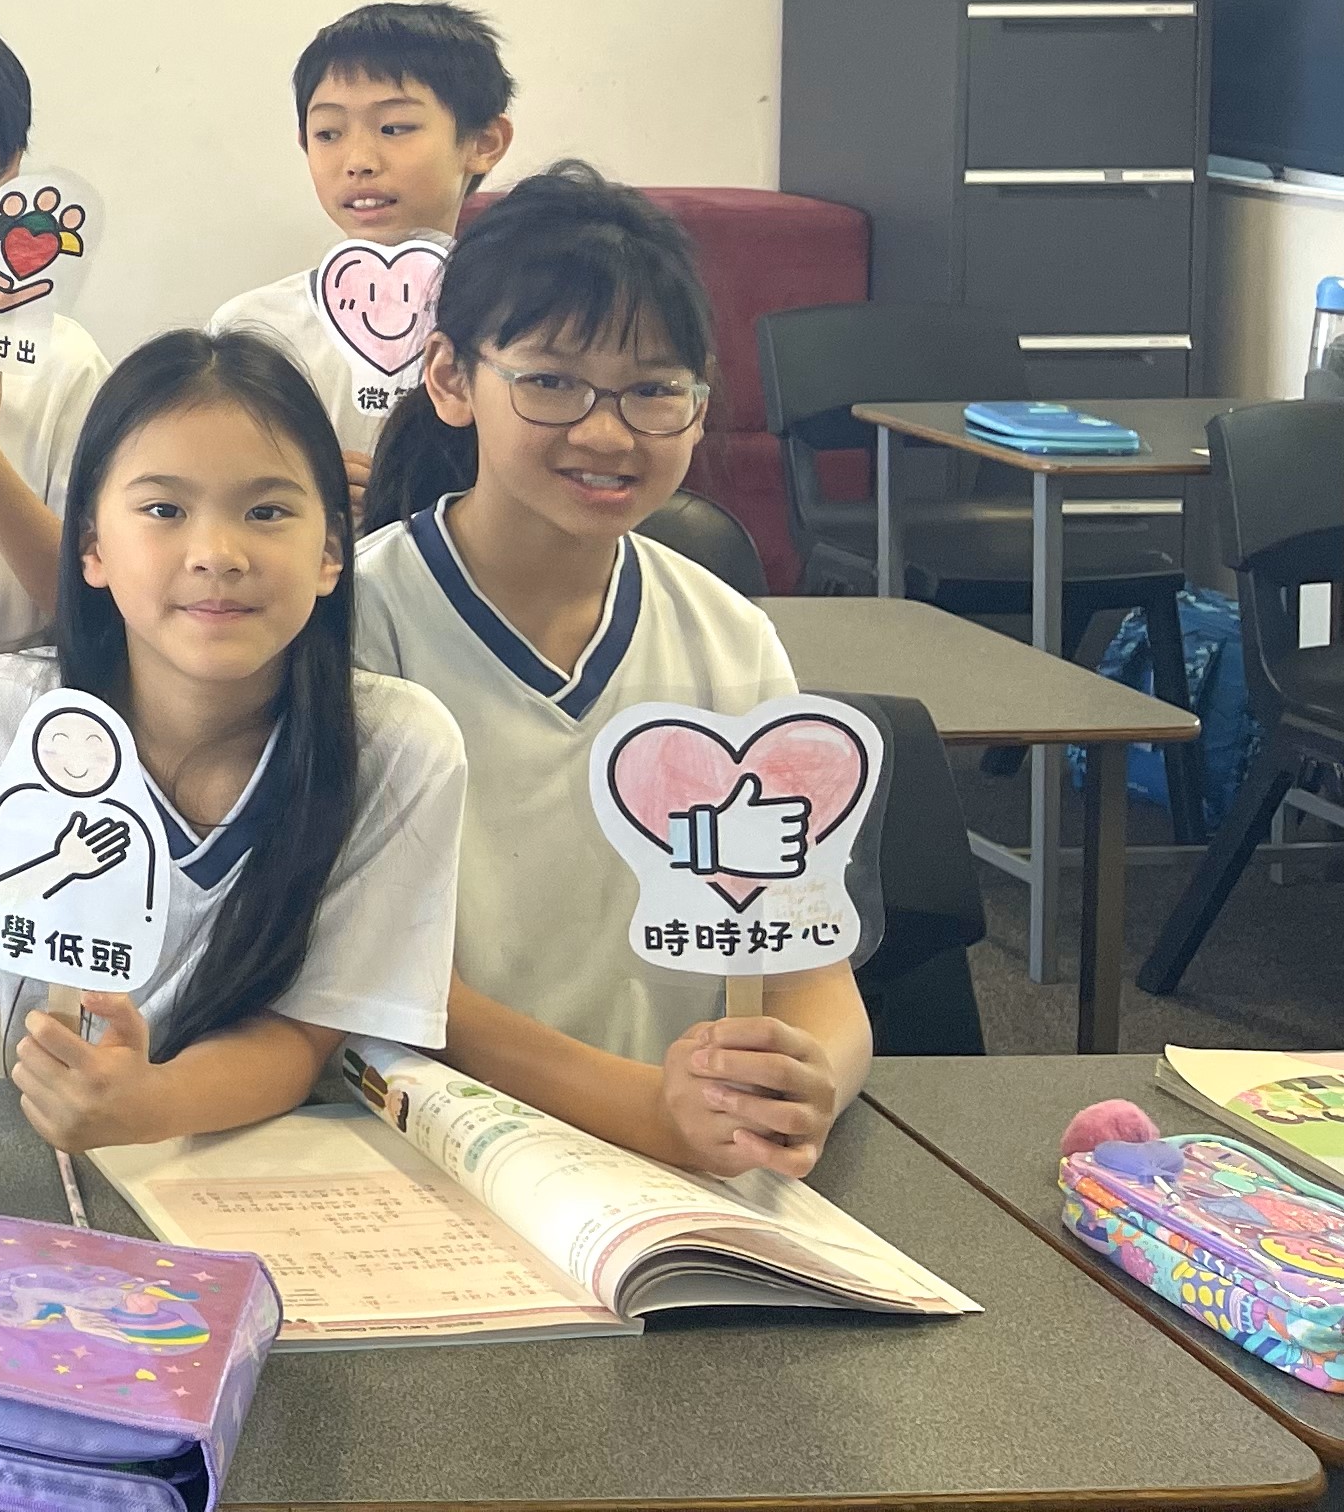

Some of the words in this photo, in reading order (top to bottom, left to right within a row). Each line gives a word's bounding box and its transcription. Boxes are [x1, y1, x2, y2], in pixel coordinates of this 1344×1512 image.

[1, 914, 133, 980] 學低頭
[644, 918, 841, 956] 時時好心
